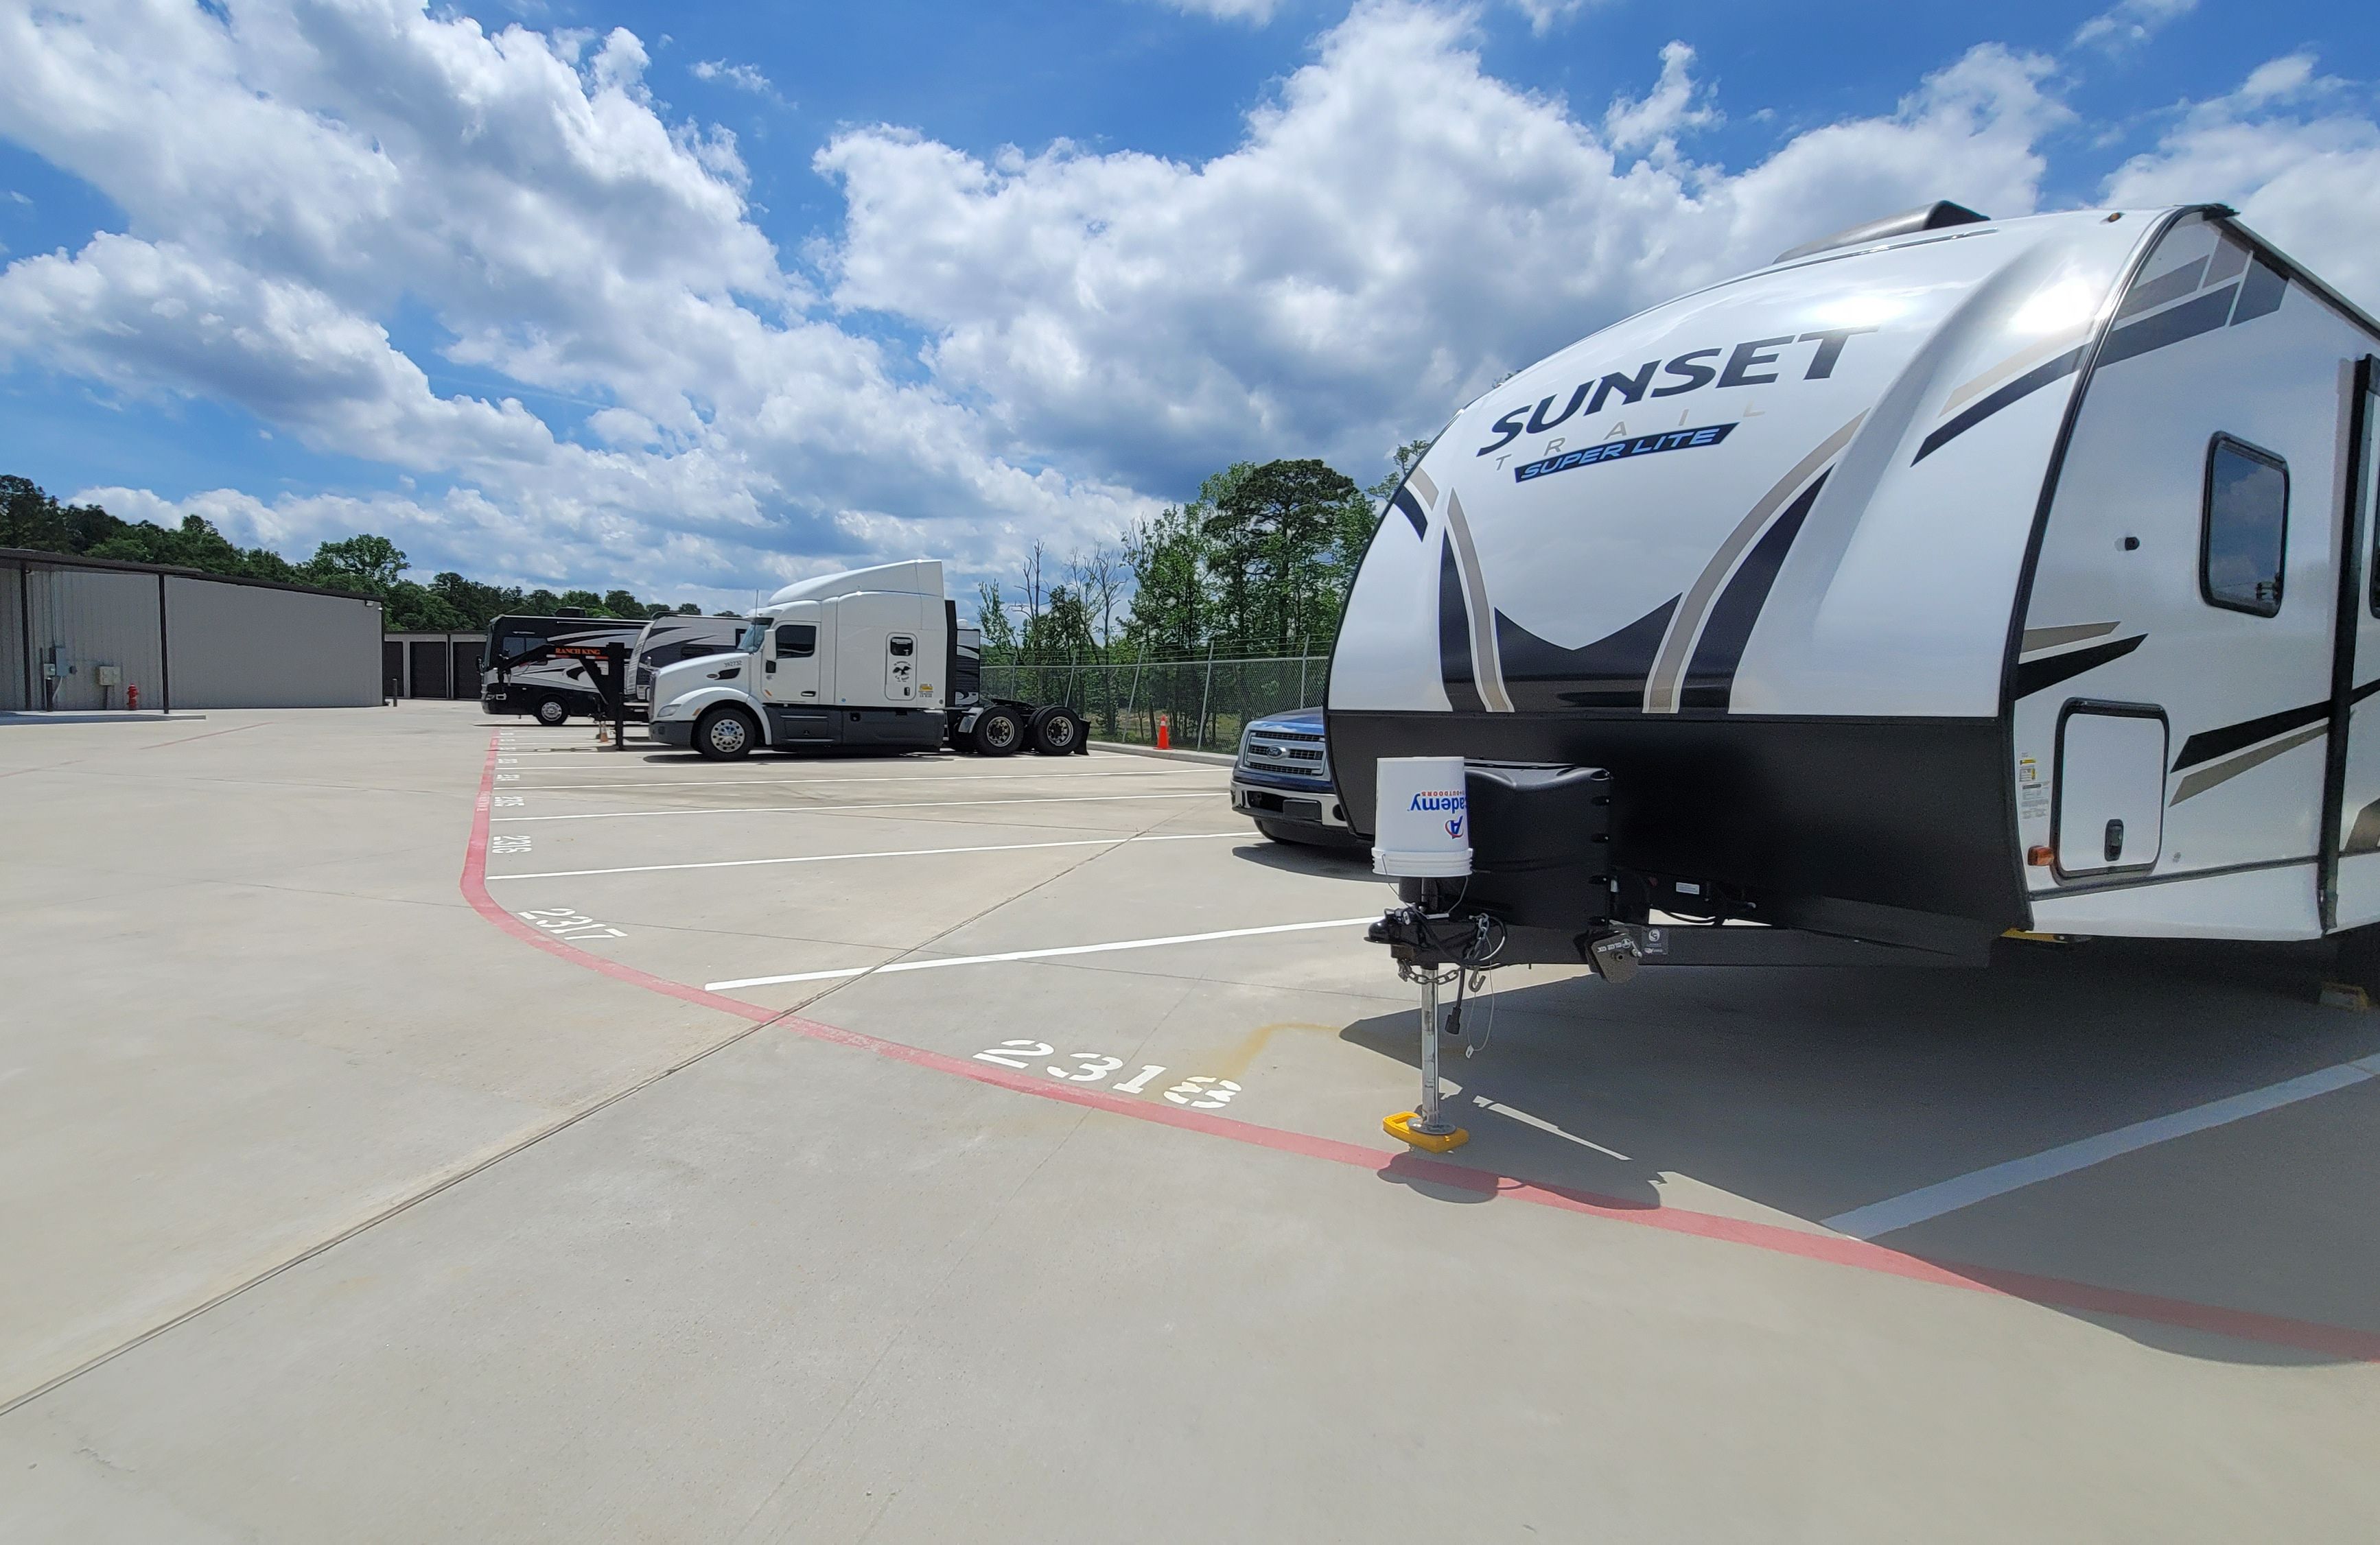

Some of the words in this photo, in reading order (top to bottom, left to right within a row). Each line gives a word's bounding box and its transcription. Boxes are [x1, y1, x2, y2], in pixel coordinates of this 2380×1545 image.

[1476, 324, 1880, 458] SUNSET
[1495, 399, 1766, 471] TRAIL
[1519, 443, 1624, 480] SUPER
[1631, 427, 1721, 454] LITE
[492, 835, 533, 854] 2316
[517, 907, 629, 941] 2317
[972, 1039, 1242, 1109] 2318
